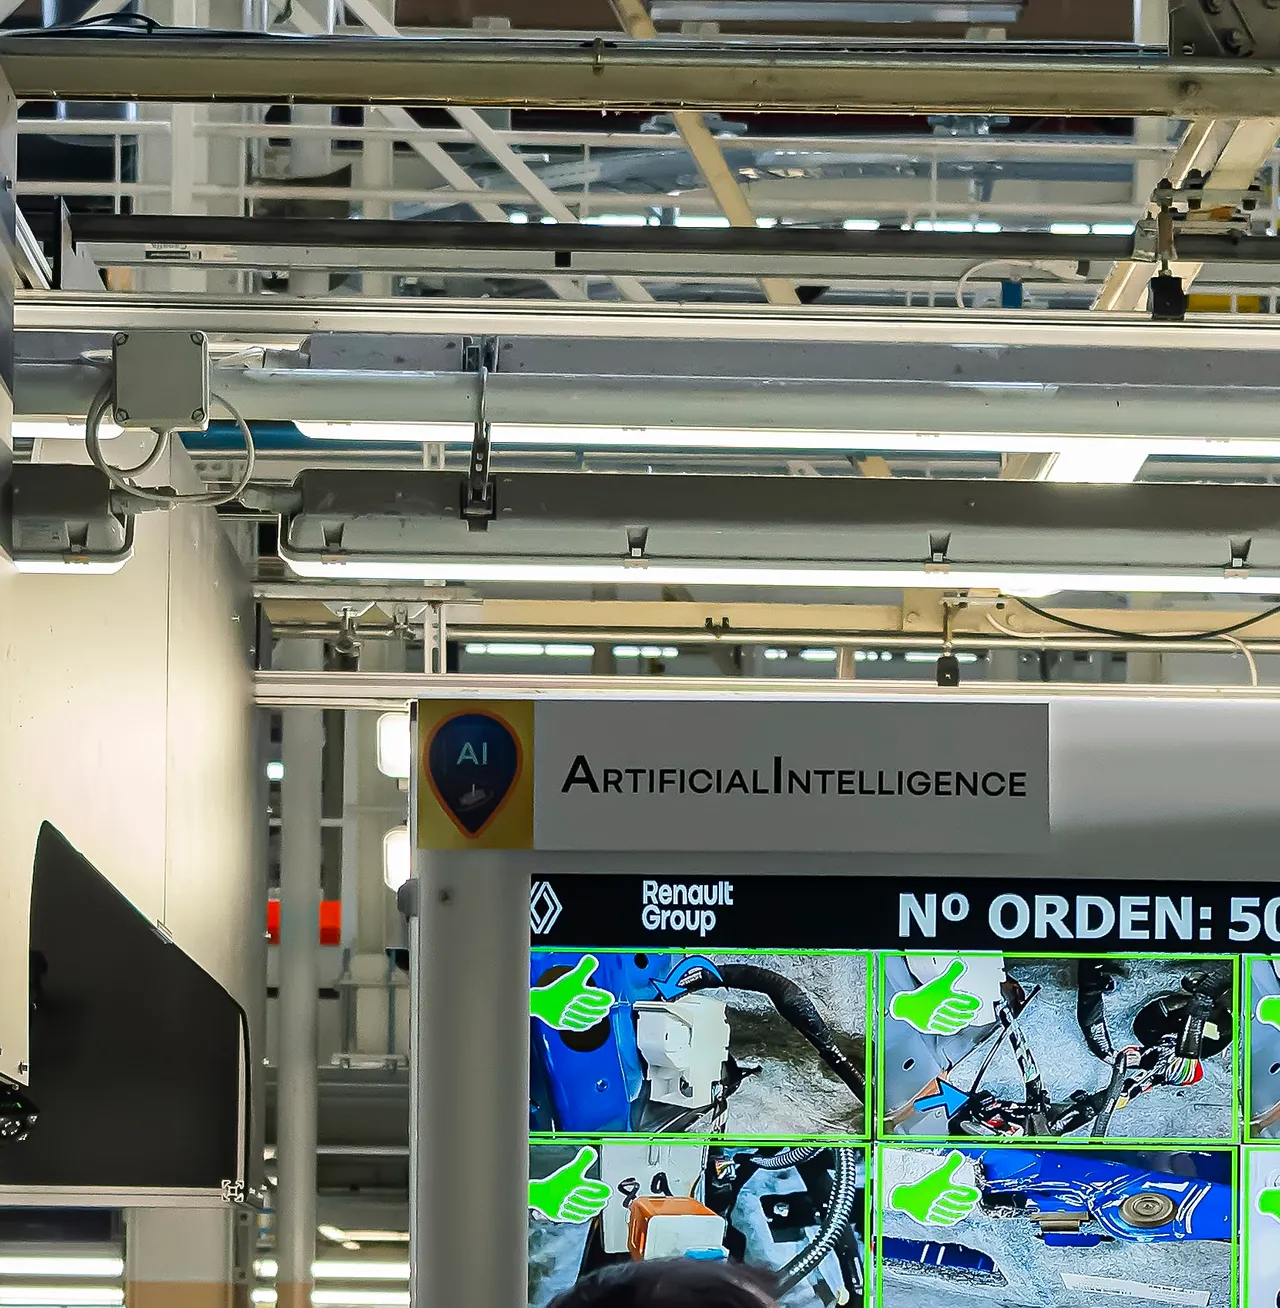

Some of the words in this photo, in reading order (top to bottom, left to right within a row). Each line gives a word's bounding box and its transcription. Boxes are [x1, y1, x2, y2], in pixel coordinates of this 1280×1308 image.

[456, 741, 488, 765] AI
[642, 880, 734, 906] Renault
[641, 904, 717, 938] Group
[988, 894, 1213, 941] ORDEN:
